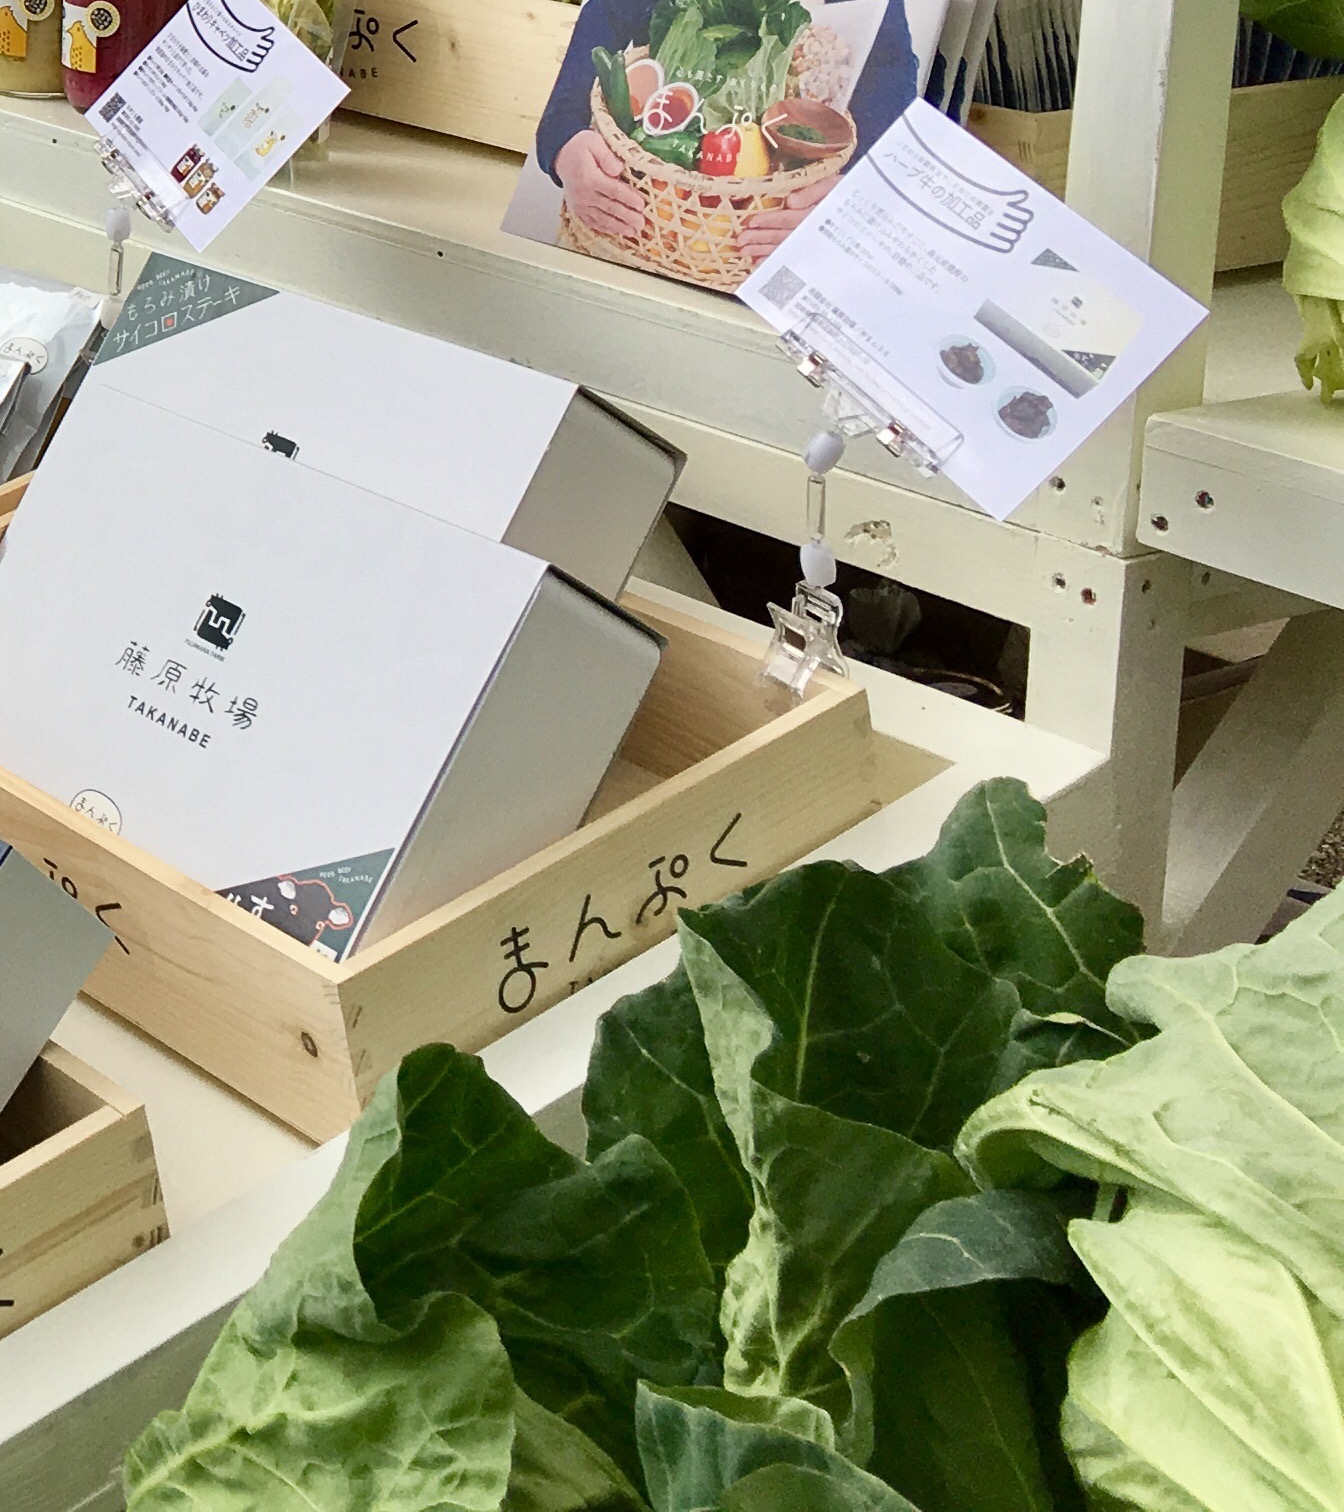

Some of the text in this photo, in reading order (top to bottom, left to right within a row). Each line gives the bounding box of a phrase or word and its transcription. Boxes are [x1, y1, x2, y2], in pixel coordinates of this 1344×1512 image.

[642, 88, 789, 149] まんぷく
[883, 150, 988, 233] ハーブ牛の加工品
[112, 285, 242, 353] サイコロステーキ
[125, 274, 212, 322] もろみ漬け
[114, 639, 260, 731] 藤原牧場
[126, 694, 213, 750] TAKANABE
[497, 811, 750, 1015] まんぷく
